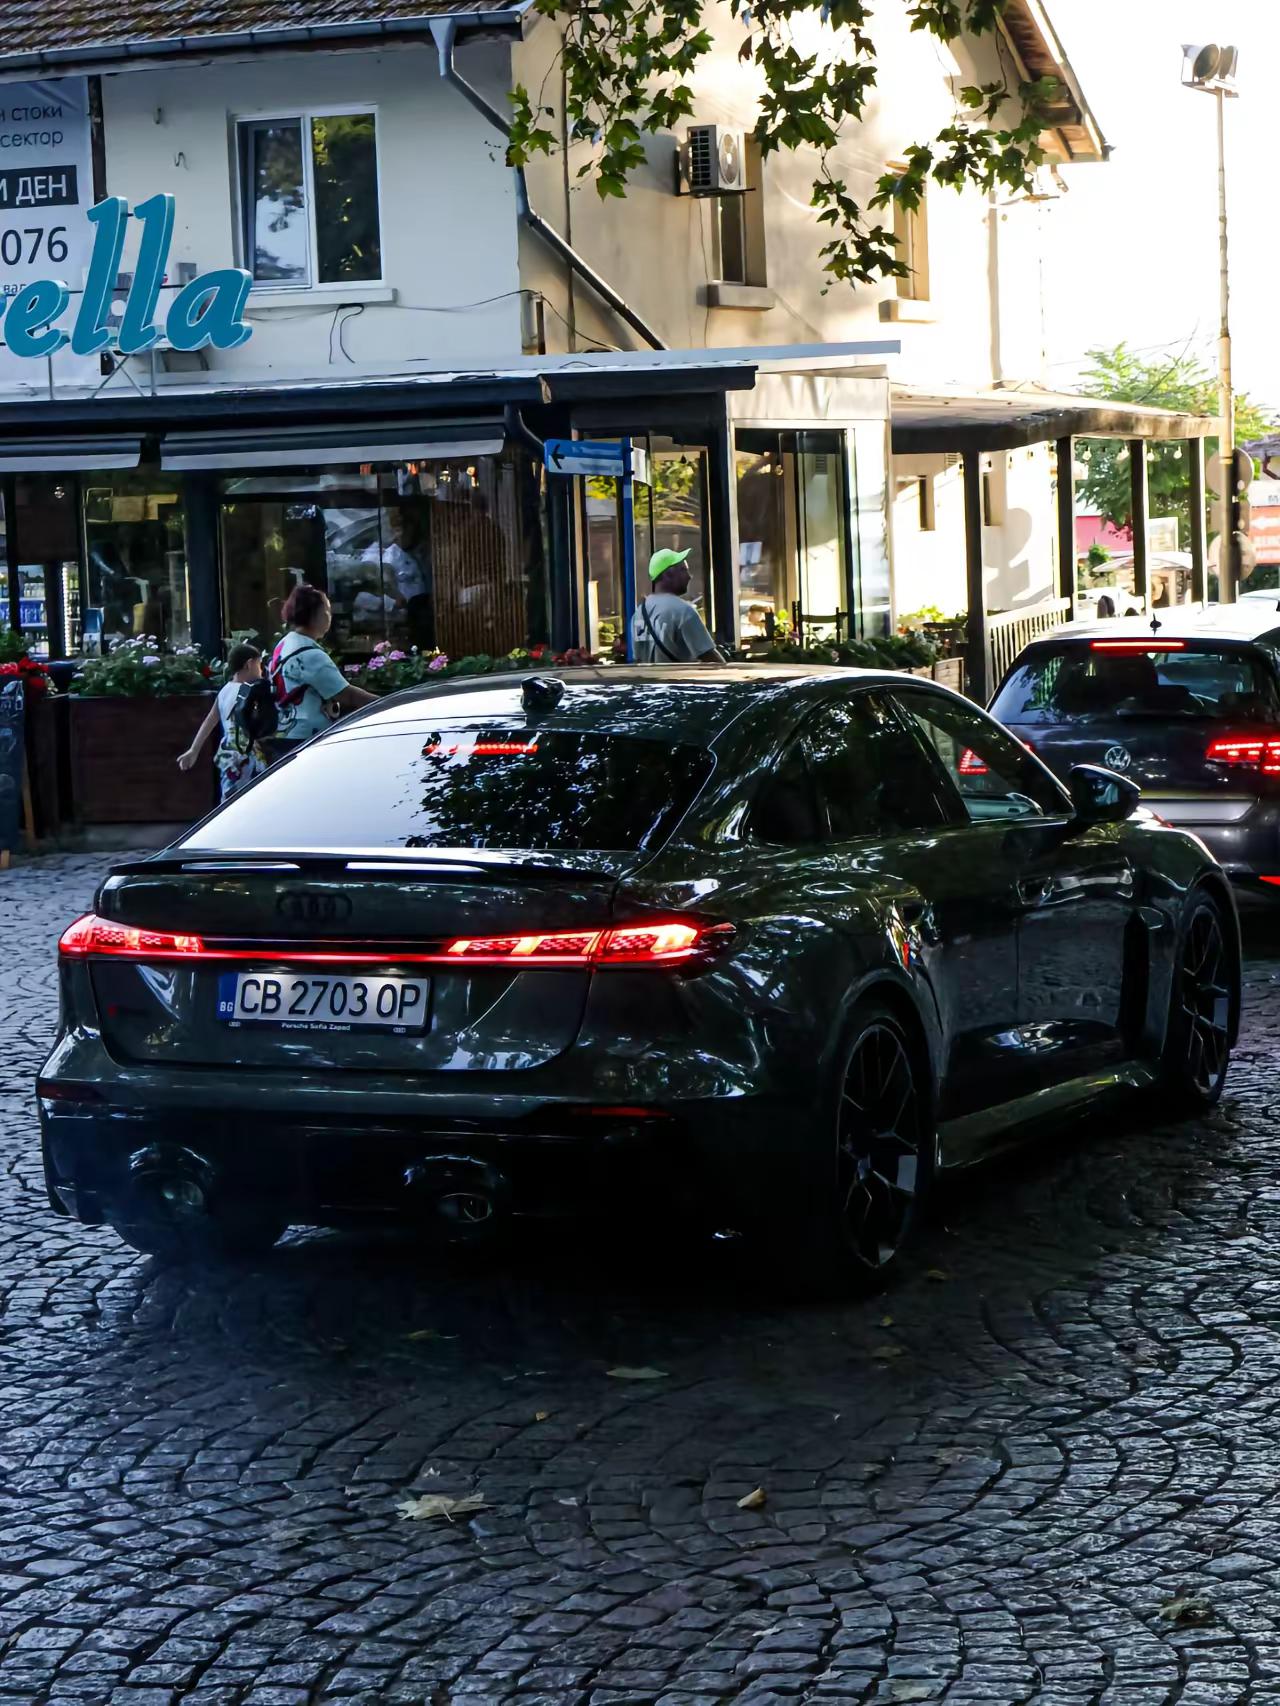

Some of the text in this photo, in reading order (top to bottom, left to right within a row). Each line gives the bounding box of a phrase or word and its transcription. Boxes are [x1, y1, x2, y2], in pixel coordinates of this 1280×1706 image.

[11, 106, 63, 121] стоки
[1, 130, 63, 149] сектор
[15, 174, 67, 205] ДЕН
[1, 226, 68, 266] 076
[0, 192, 252, 357] ella
[219, 1001, 234, 1012] BG
[239, 979, 421, 1020] CB 2703 OP
